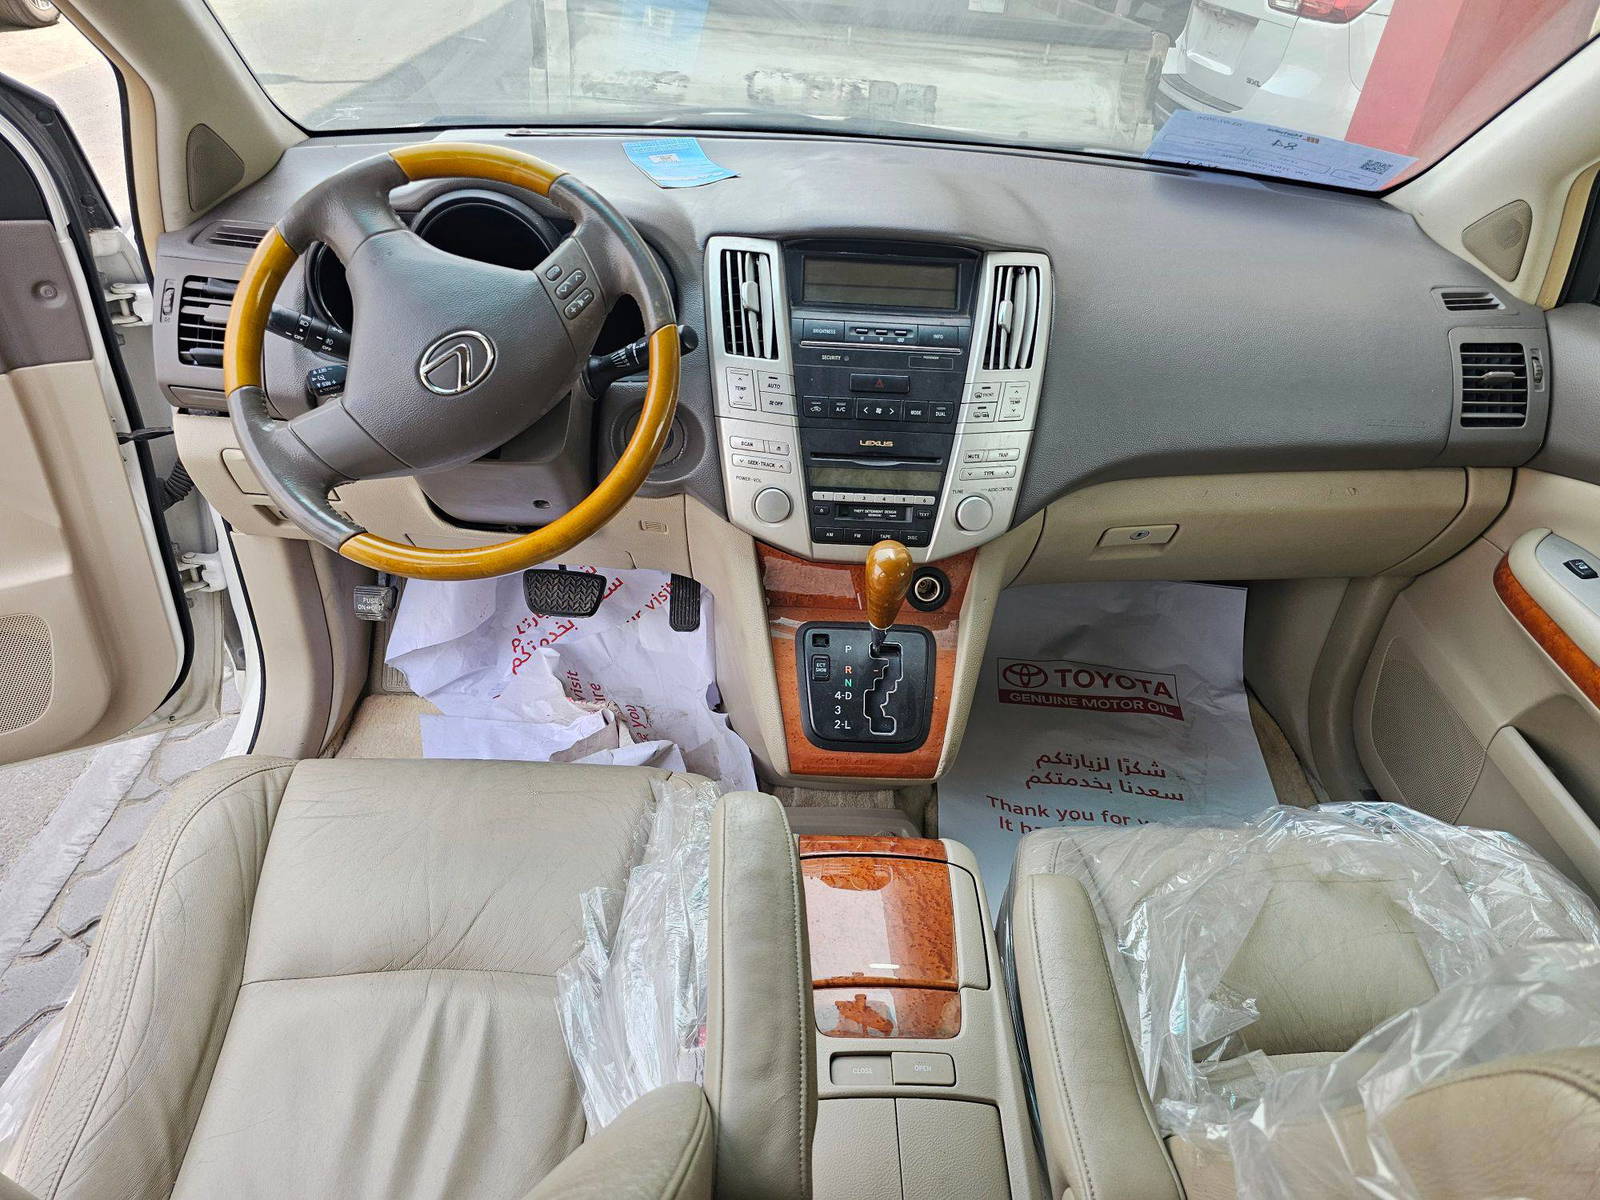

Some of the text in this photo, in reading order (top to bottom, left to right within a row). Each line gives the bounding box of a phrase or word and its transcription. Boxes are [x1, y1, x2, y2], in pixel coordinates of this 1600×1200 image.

[845, 645, 852, 653] P
[845, 666, 852, 674] R
[845, 679, 852, 687] N
[1054, 669, 1174, 699] TOYOTA
[834, 706, 841, 714] 3
[1008, 692, 1174, 716] GENUINE MOTOR OIL
[1035, 752, 1110, 772] لزيارتكم
[1025, 771, 1184, 802] سعدنا بخدمتكم
[986, 795, 1050, 818] Thank
[1056, 808, 1094, 824] you
[1101, 809, 1130, 826] for
[998, 816, 1014, 832] It
